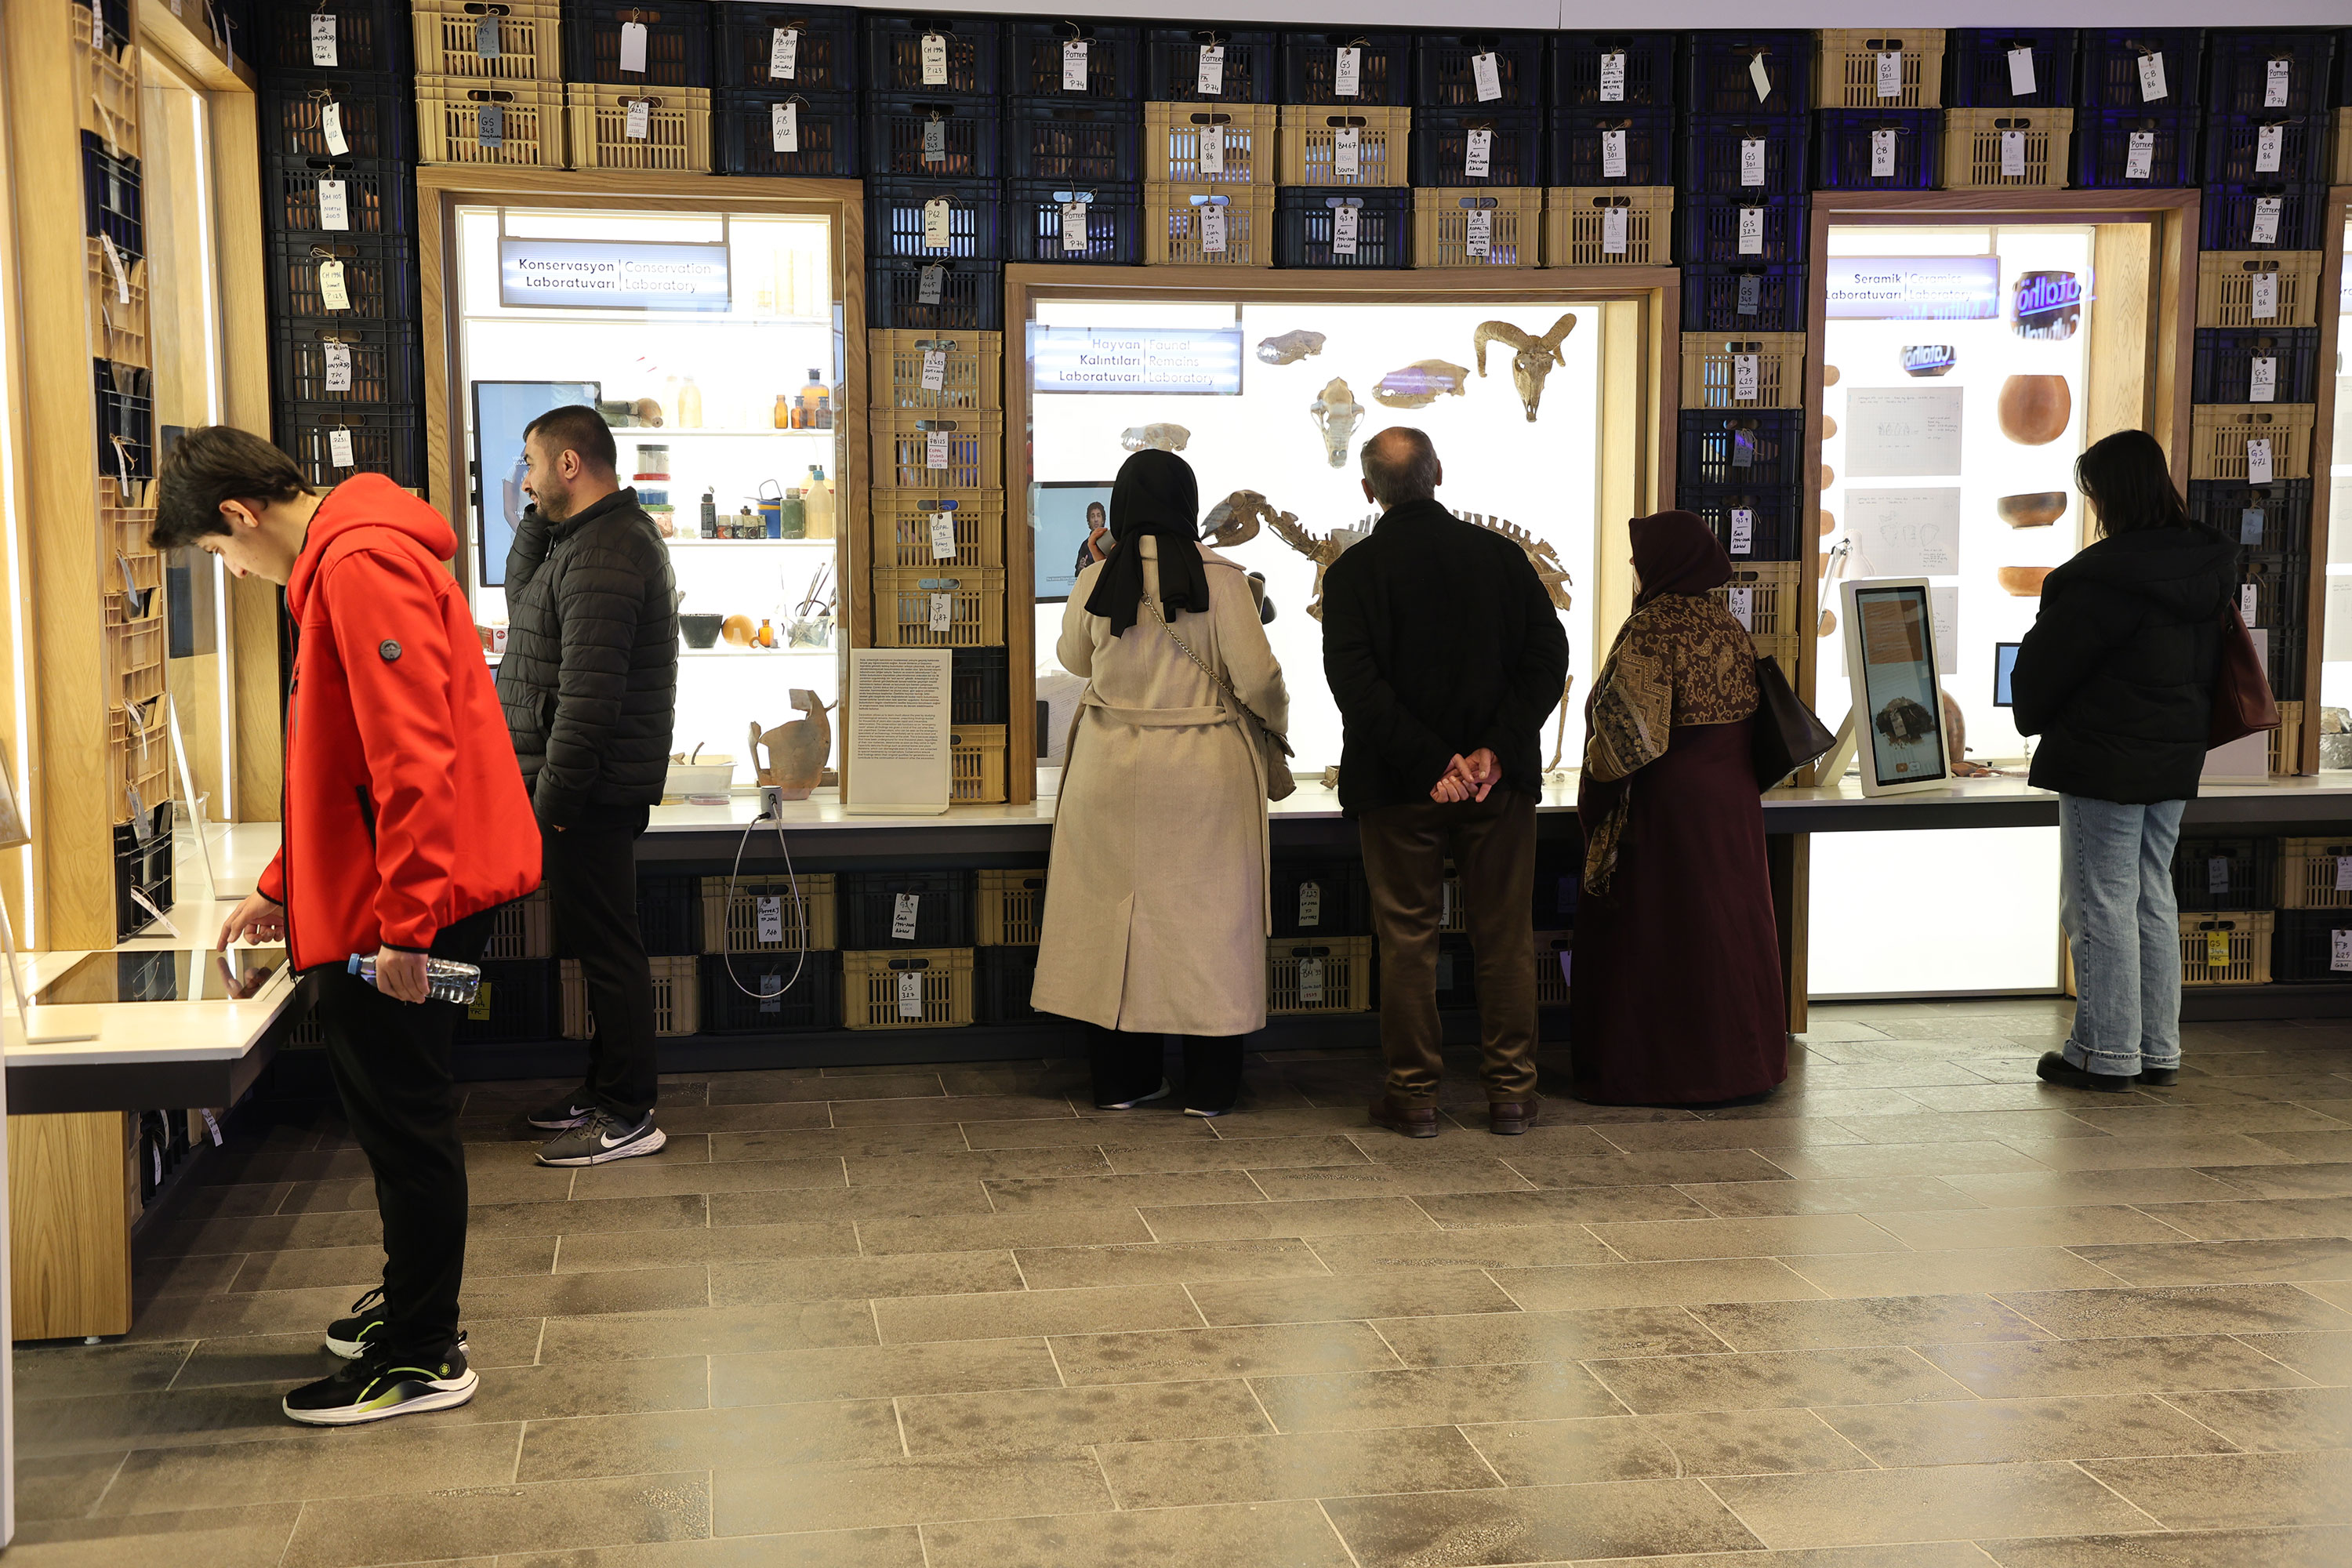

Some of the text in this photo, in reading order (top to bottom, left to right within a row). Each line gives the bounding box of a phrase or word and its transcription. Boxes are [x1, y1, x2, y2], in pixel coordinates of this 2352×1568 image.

[1340, 60, 1351, 69] GS
[1880, 64, 1891, 72] GS
[481, 117, 495, 126] GS
[926, 132, 938, 142] GS
[1606, 143, 1617, 151] GS
[1744, 152, 1755, 161] GS
[518, 258, 711, 274] Konservasyon Conservation
[1854, 274, 1962, 285] Seramik Ceramics
[526, 276, 697, 294] Laboratuvarı Laboratory
[1741, 287, 1752, 296] GS
[1826, 290, 1973, 302] Laboratuvarı Laboratory
[1093, 339, 1191, 352] Hayvan Faunal
[1080, 354, 1200, 368] Kalıntıları Remains
[1059, 371, 1214, 386] Laboratuvarı Laboratory
[2251, 449, 2263, 458] GS
[2244, 595, 2251, 604] GS
